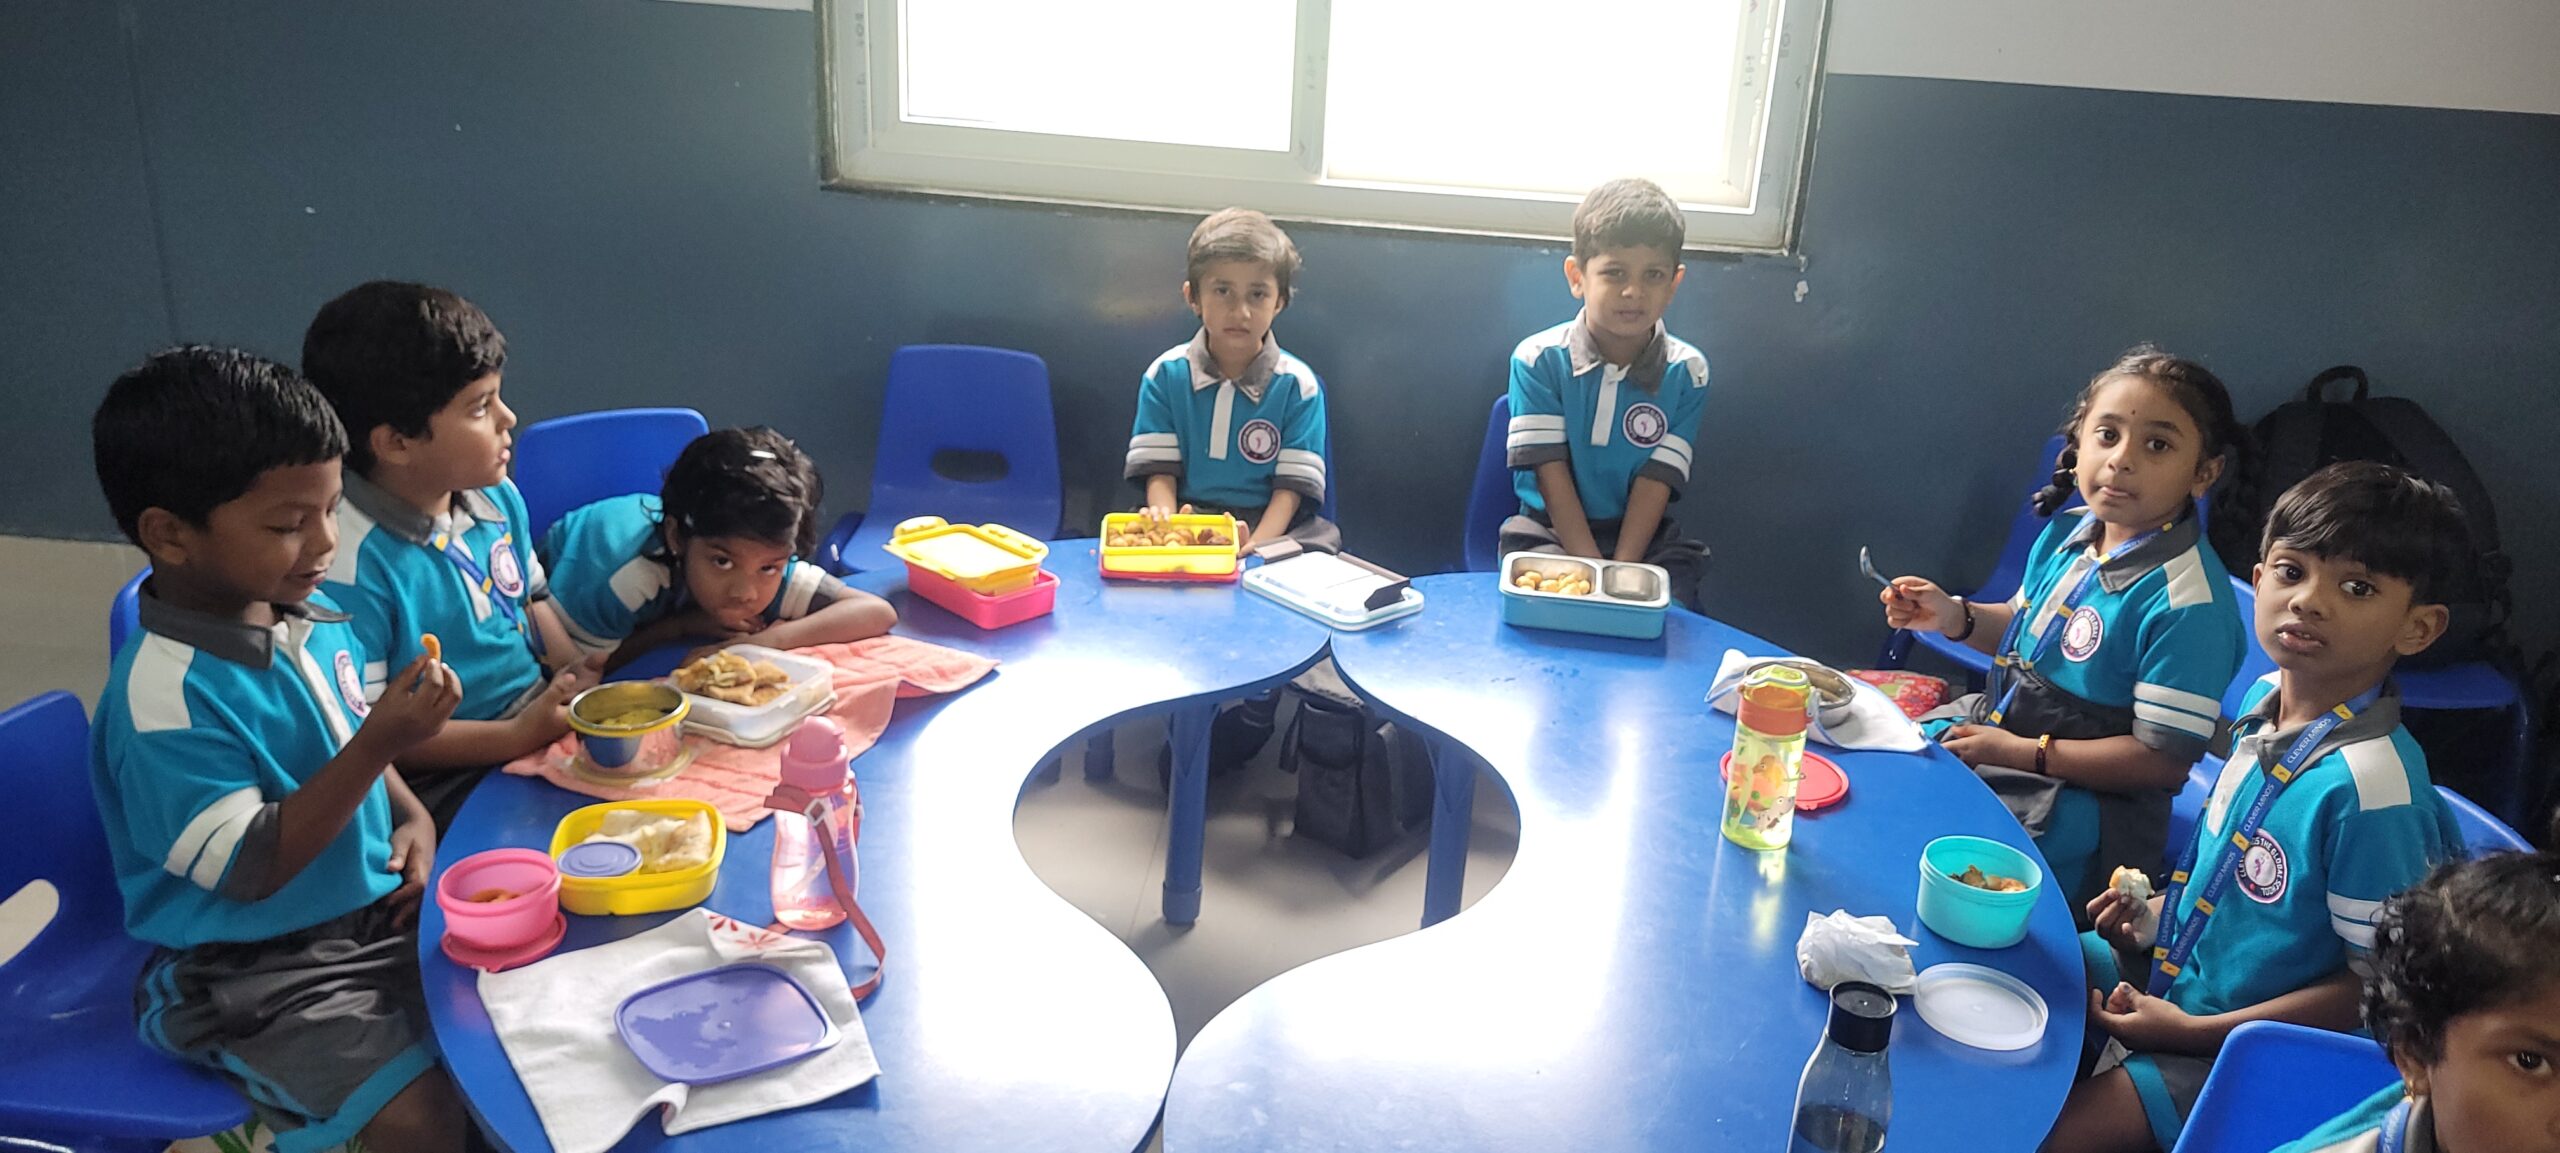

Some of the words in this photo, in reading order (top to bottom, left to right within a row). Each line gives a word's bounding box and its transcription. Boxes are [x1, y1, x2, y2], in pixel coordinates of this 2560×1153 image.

[2286, 737, 2310, 764] CLEVER
[2309, 716, 2332, 740] MINDS
[2243, 806, 2261, 832] CLEVER
[2257, 782, 2275, 806] MINDS
[2207, 871, 2225, 898] CLEVER
[2221, 850, 2236, 872] MINDS
[2271, 848, 2283, 879] GLOBAL
[2160, 913, 2172, 942] CLEVER
[2167, 888, 2179, 914] MINDS
[2171, 934, 2189, 960] CLEVER
[2185, 914, 2201, 937] MINDS
